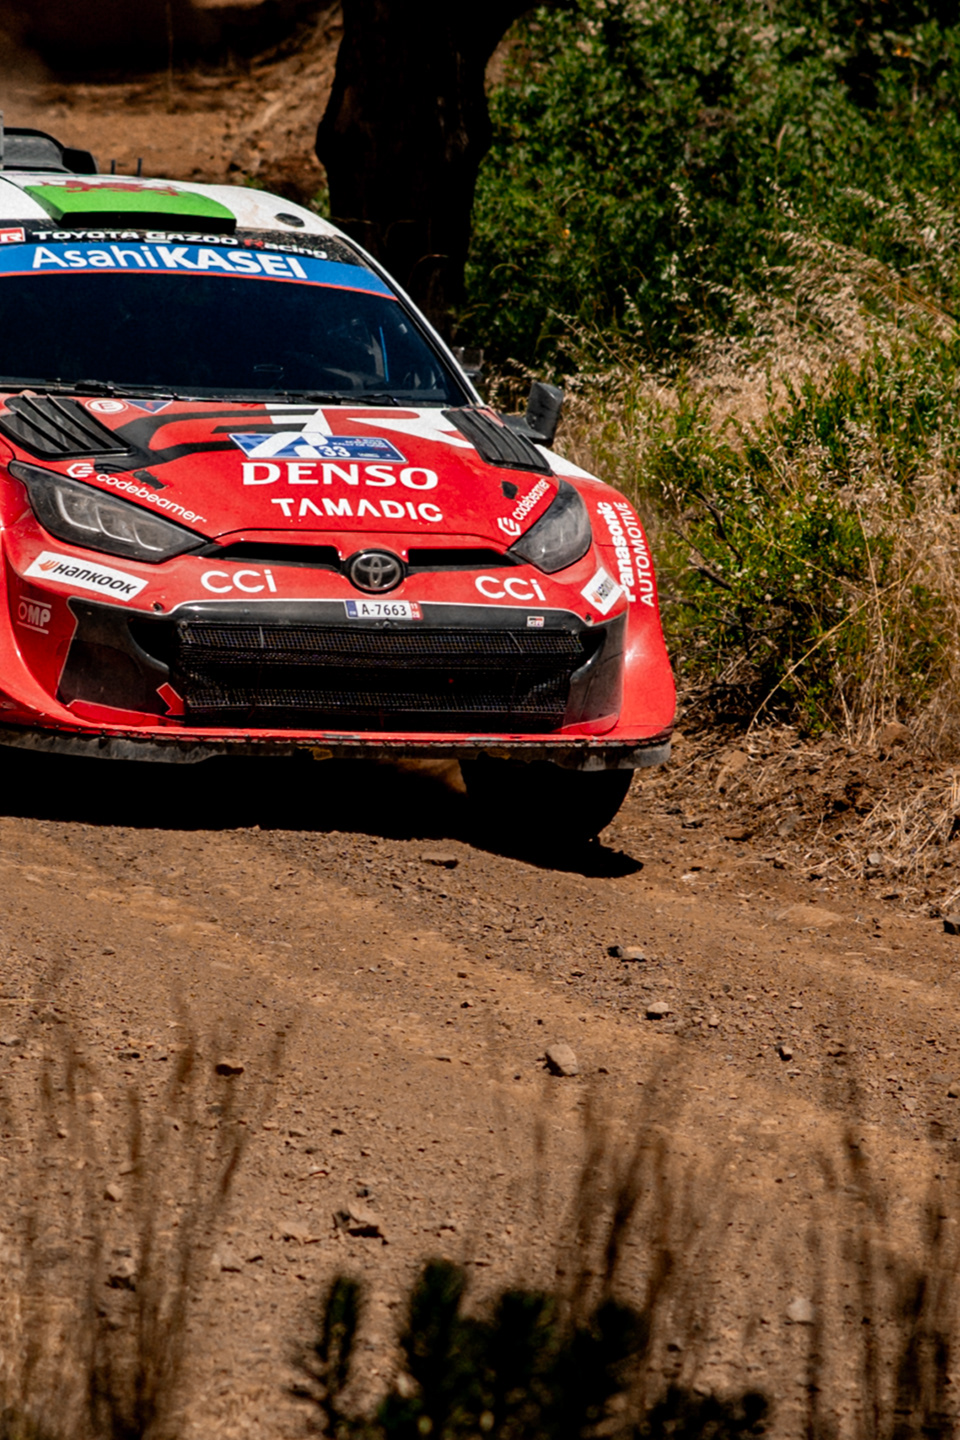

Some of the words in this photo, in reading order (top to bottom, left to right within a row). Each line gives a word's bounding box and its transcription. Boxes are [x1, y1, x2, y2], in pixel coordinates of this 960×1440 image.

[32, 231, 140, 240] TOYOTA
[145, 231, 239, 246] GAZOO
[243, 238, 328, 259] Racing
[32, 245, 308, 279] AsahiKASEI
[319, 446, 351, 457] 33
[241, 462, 439, 490] DENSO
[96, 473, 205, 524] codebeamer
[271, 498, 443, 523] TAMADIC
[597, 501, 636, 603] Panasonic
[614, 501, 655, 607] AUTOMOTIVE
[18, 602, 51, 627] OMP
[361, 603, 407, 616] A-7663
